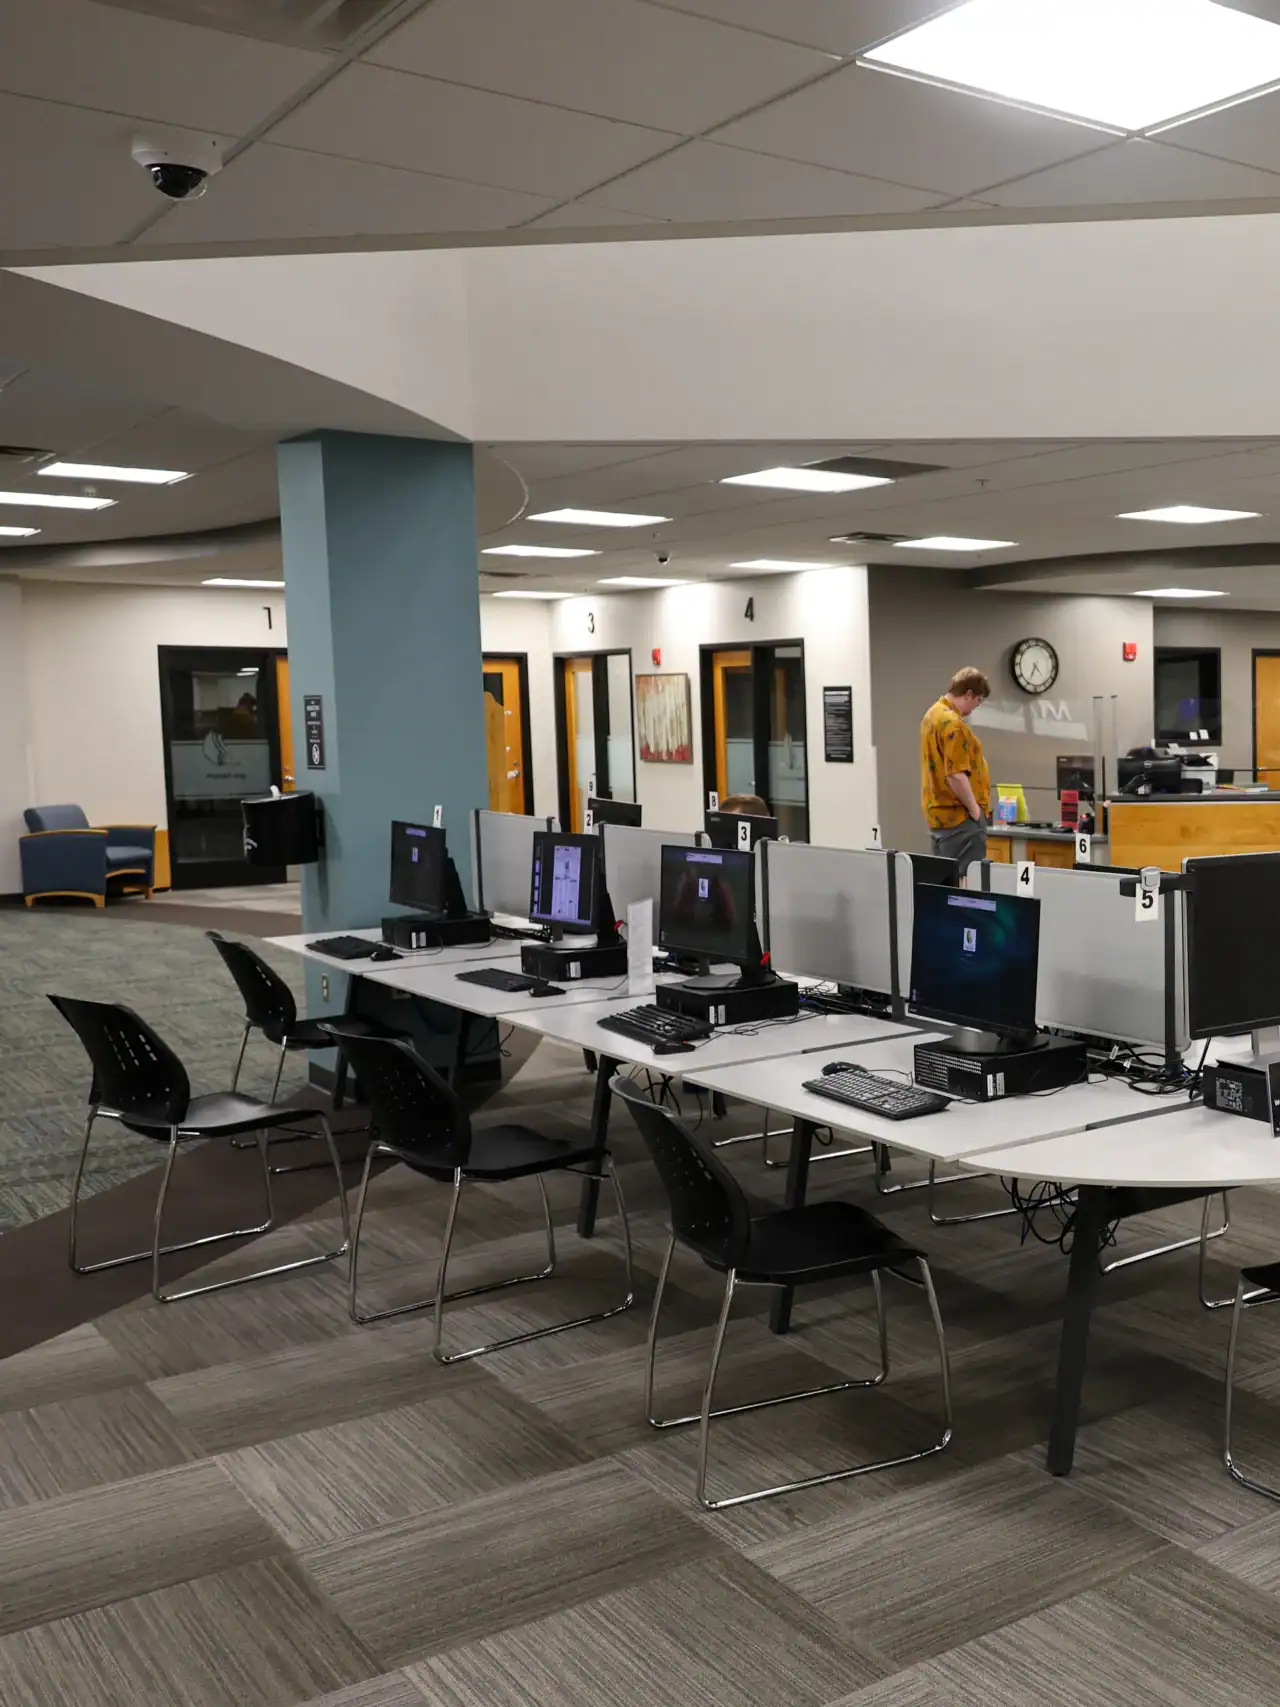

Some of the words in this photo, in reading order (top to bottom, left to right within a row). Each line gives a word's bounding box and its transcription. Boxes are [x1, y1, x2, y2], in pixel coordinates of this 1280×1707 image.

[744, 596, 754, 622] 4
[263, 606, 272, 630] 1
[588, 612, 595, 634] 3
[588, 781, 593, 791] 9
[711, 795, 717, 807] 8
[435, 809, 440, 821] 1
[586, 813, 592, 827] 2
[740, 826, 748, 841] 3
[872, 828, 878, 841] 7
[1079, 838, 1087, 853] 6
[1020, 866, 1030, 885] 4
[1141, 891, 1154, 909] 5
